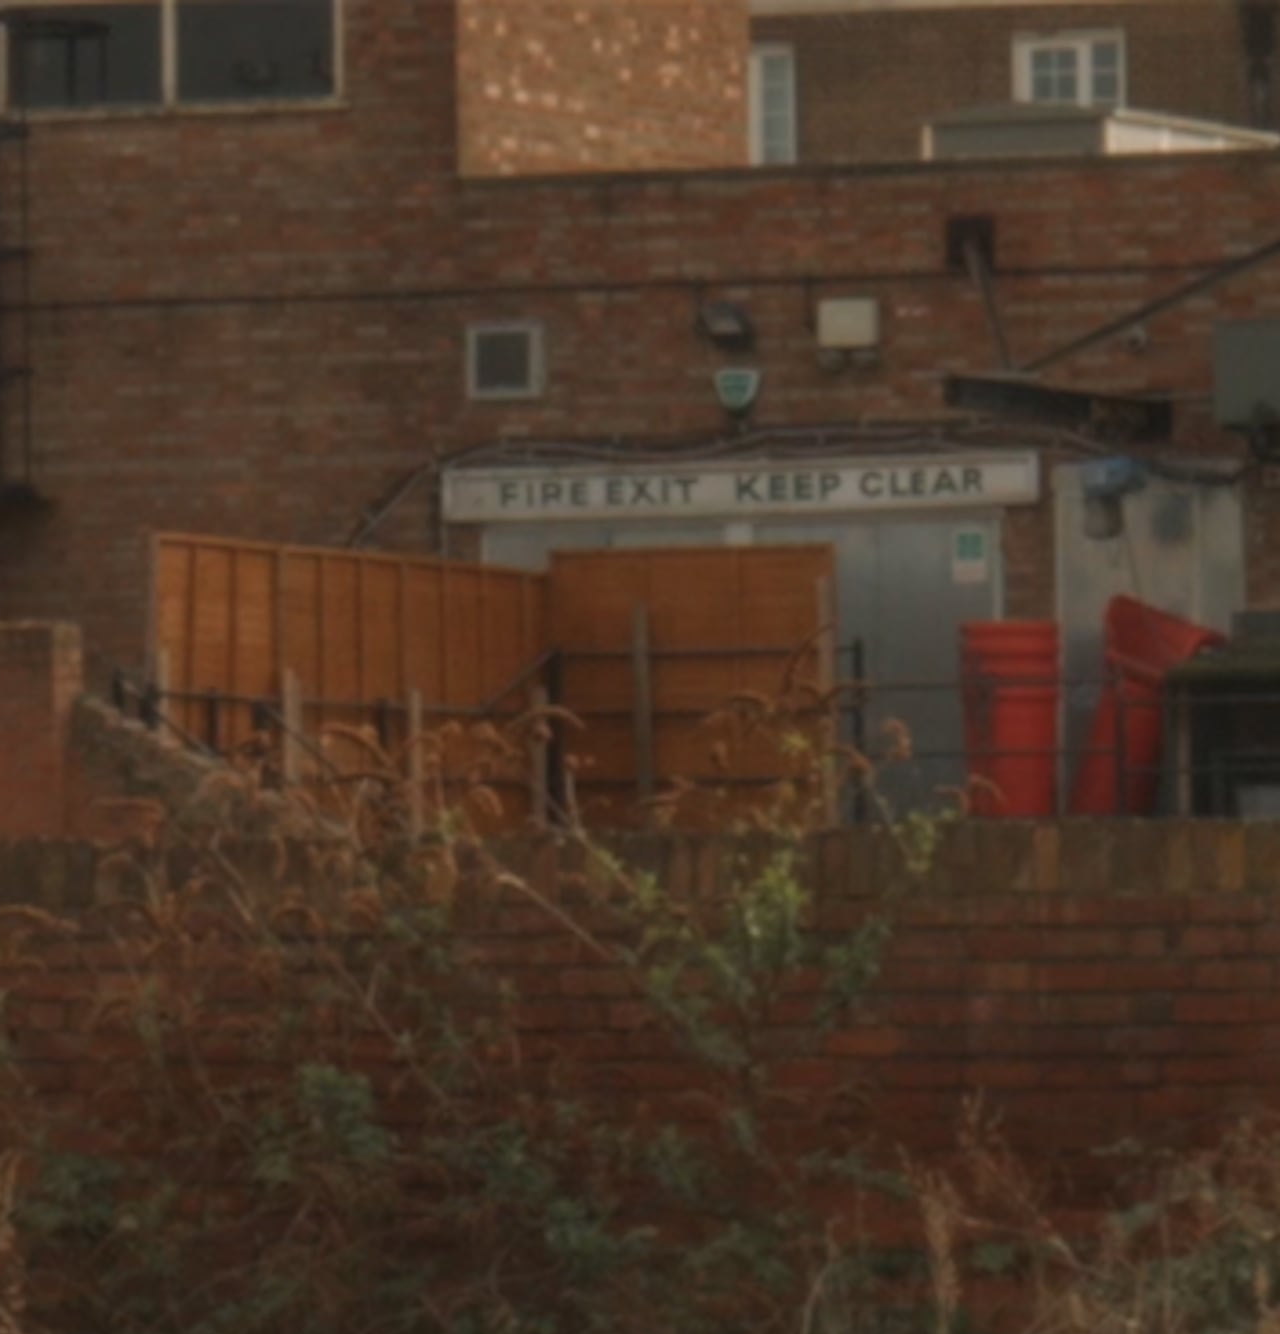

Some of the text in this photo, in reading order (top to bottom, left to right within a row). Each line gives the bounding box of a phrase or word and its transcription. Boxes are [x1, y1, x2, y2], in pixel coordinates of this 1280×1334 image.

[500, 468, 985, 508] FIRE EXIT KEEP CLEAR
